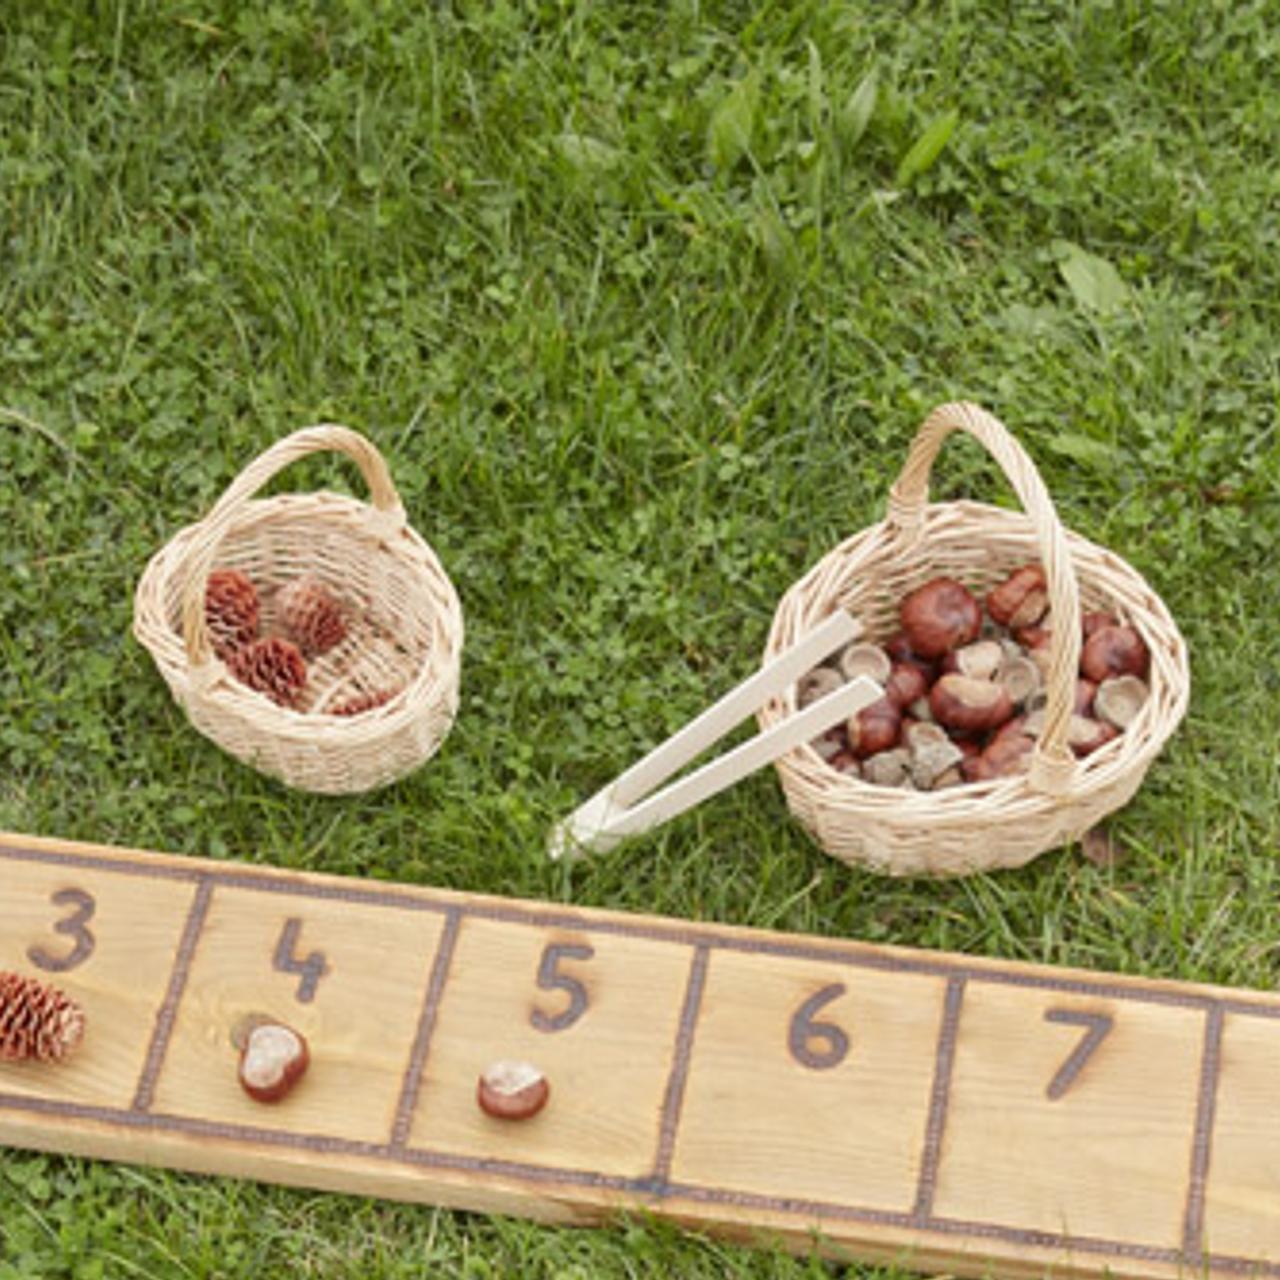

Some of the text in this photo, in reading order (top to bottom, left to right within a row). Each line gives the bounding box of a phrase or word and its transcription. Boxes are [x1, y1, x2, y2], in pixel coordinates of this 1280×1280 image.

[26, 886, 96, 973] 3
[271, 917, 331, 1004] 4
[528, 939, 594, 1033] 5
[787, 981, 851, 1071] 6
[1043, 1005, 1116, 1101] 7
